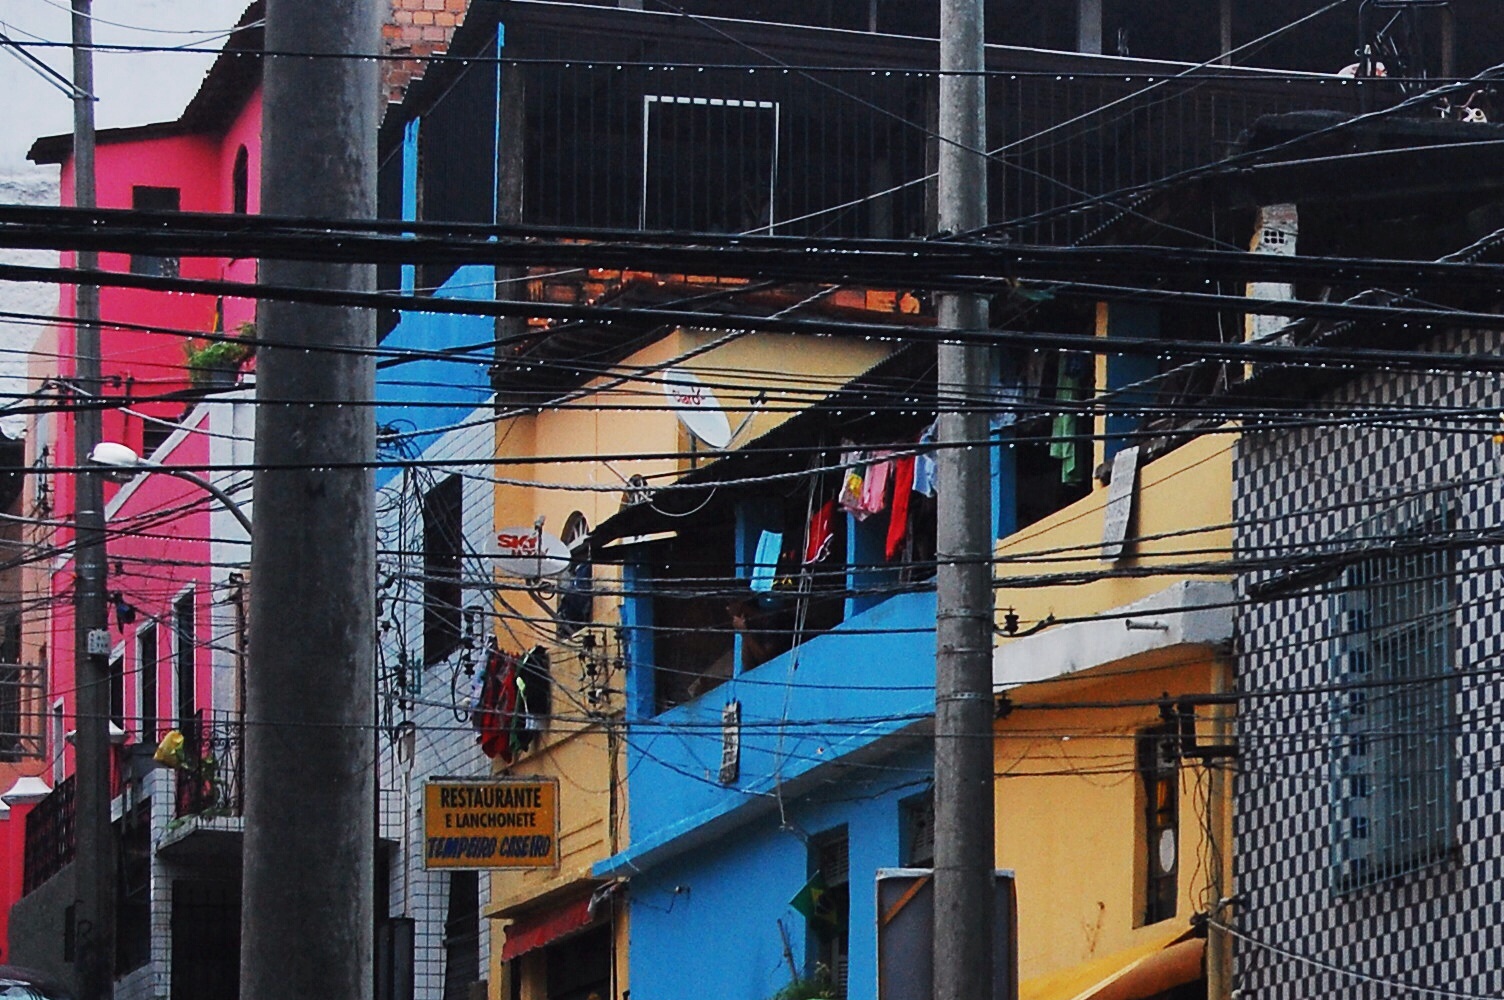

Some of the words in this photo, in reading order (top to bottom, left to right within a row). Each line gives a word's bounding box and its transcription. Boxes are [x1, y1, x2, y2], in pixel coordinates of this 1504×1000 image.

[441, 787, 542, 808] RESTAURANTE
[446, 813, 452, 828] E
[456, 812, 536, 828] LANCHONETE
[499, 835, 551, 858] CASEIRO
